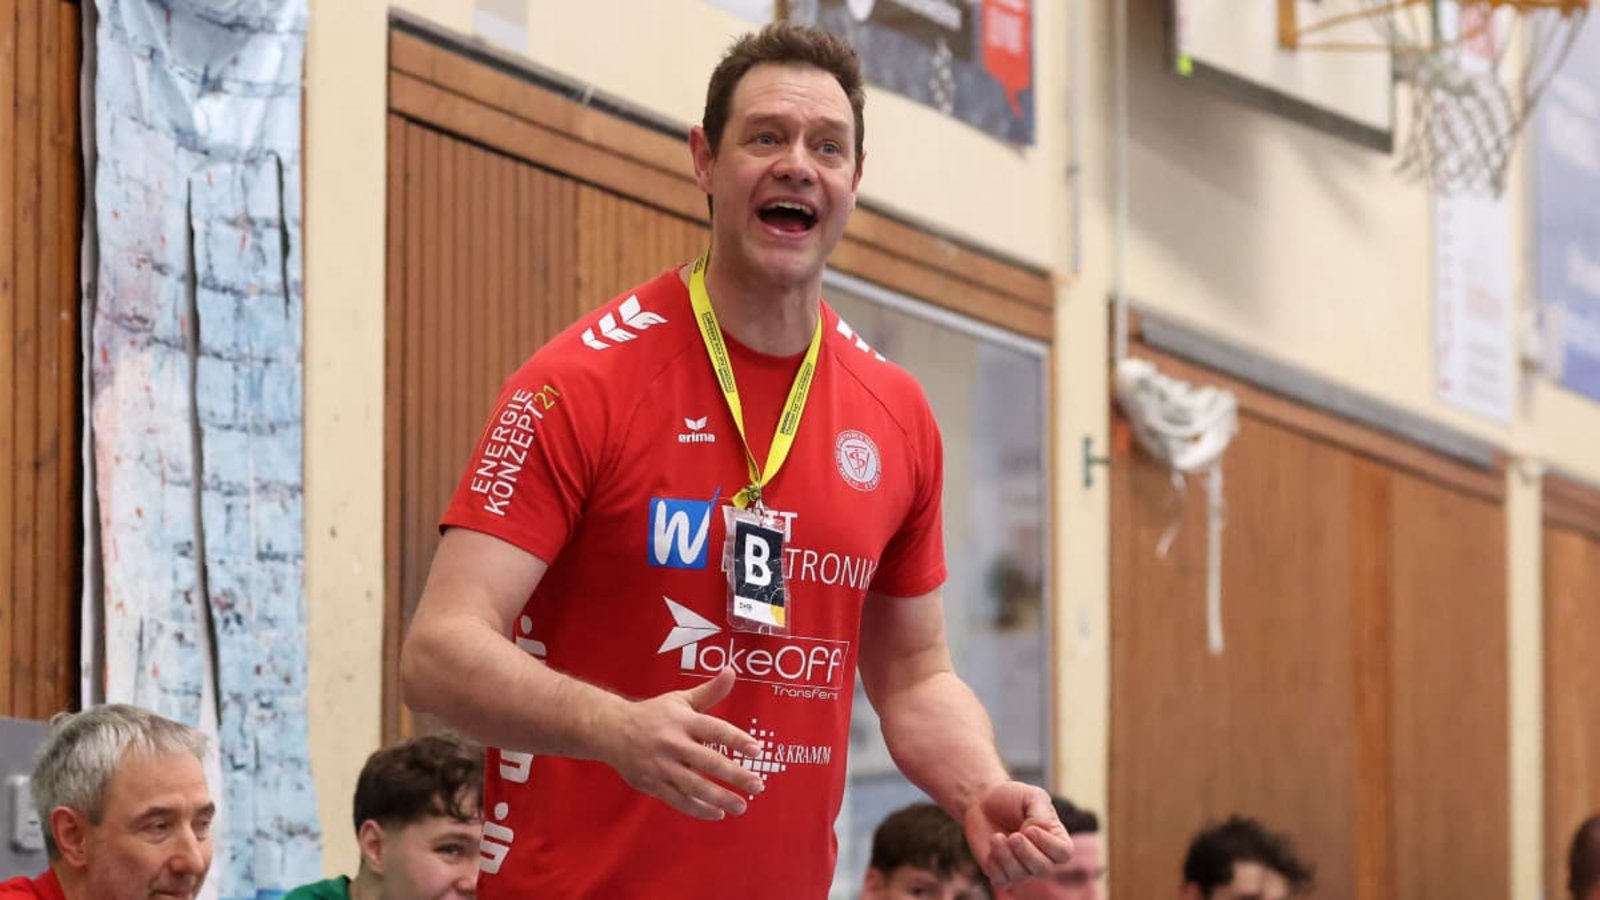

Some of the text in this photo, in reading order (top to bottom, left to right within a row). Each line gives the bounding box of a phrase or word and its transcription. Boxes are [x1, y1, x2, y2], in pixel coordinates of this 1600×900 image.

[471, 389, 533, 494] ENERGIE
[678, 431, 716, 443] erima
[744, 533, 773, 586] B
[680, 637, 843, 683] TakeOff
